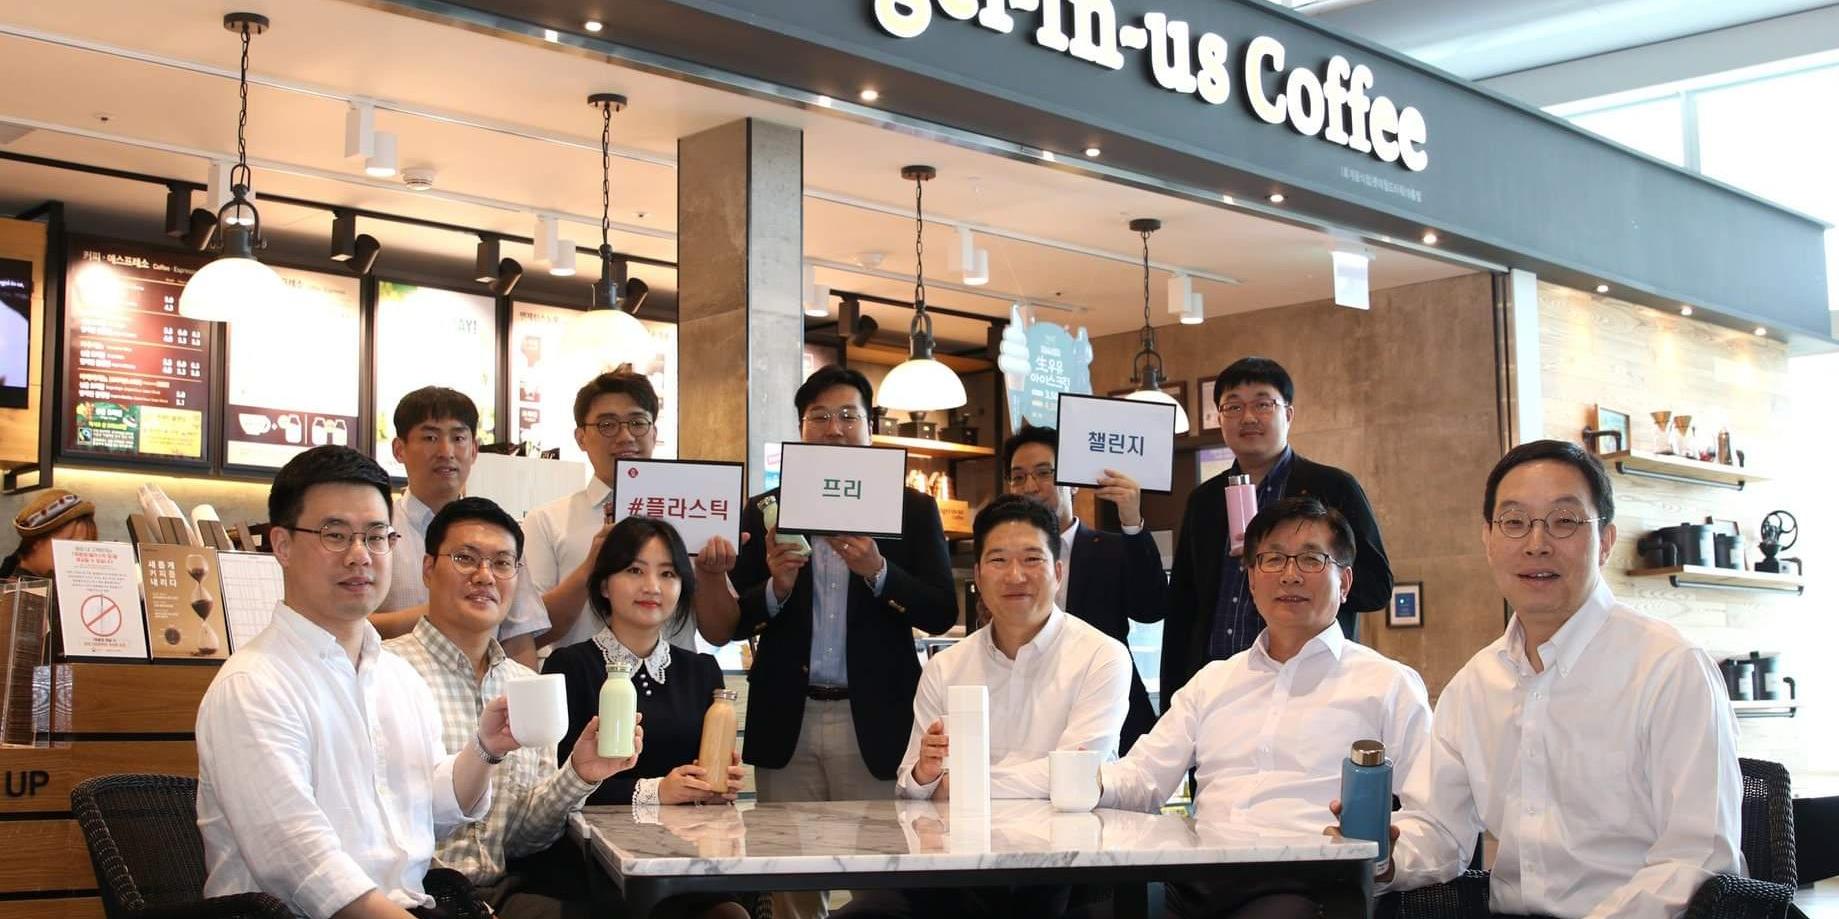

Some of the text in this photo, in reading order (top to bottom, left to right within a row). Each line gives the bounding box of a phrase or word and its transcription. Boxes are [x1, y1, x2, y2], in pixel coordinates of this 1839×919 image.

[874, 0, 1428, 171] -in-us Coffee
[1030, 373, 1071, 392] 아이스크림
[1088, 431, 1144, 456] 챌린지
[822, 479, 861, 500] 프리
[627, 497, 728, 520] #플라스틱
[5, 770, 49, 798] UP
